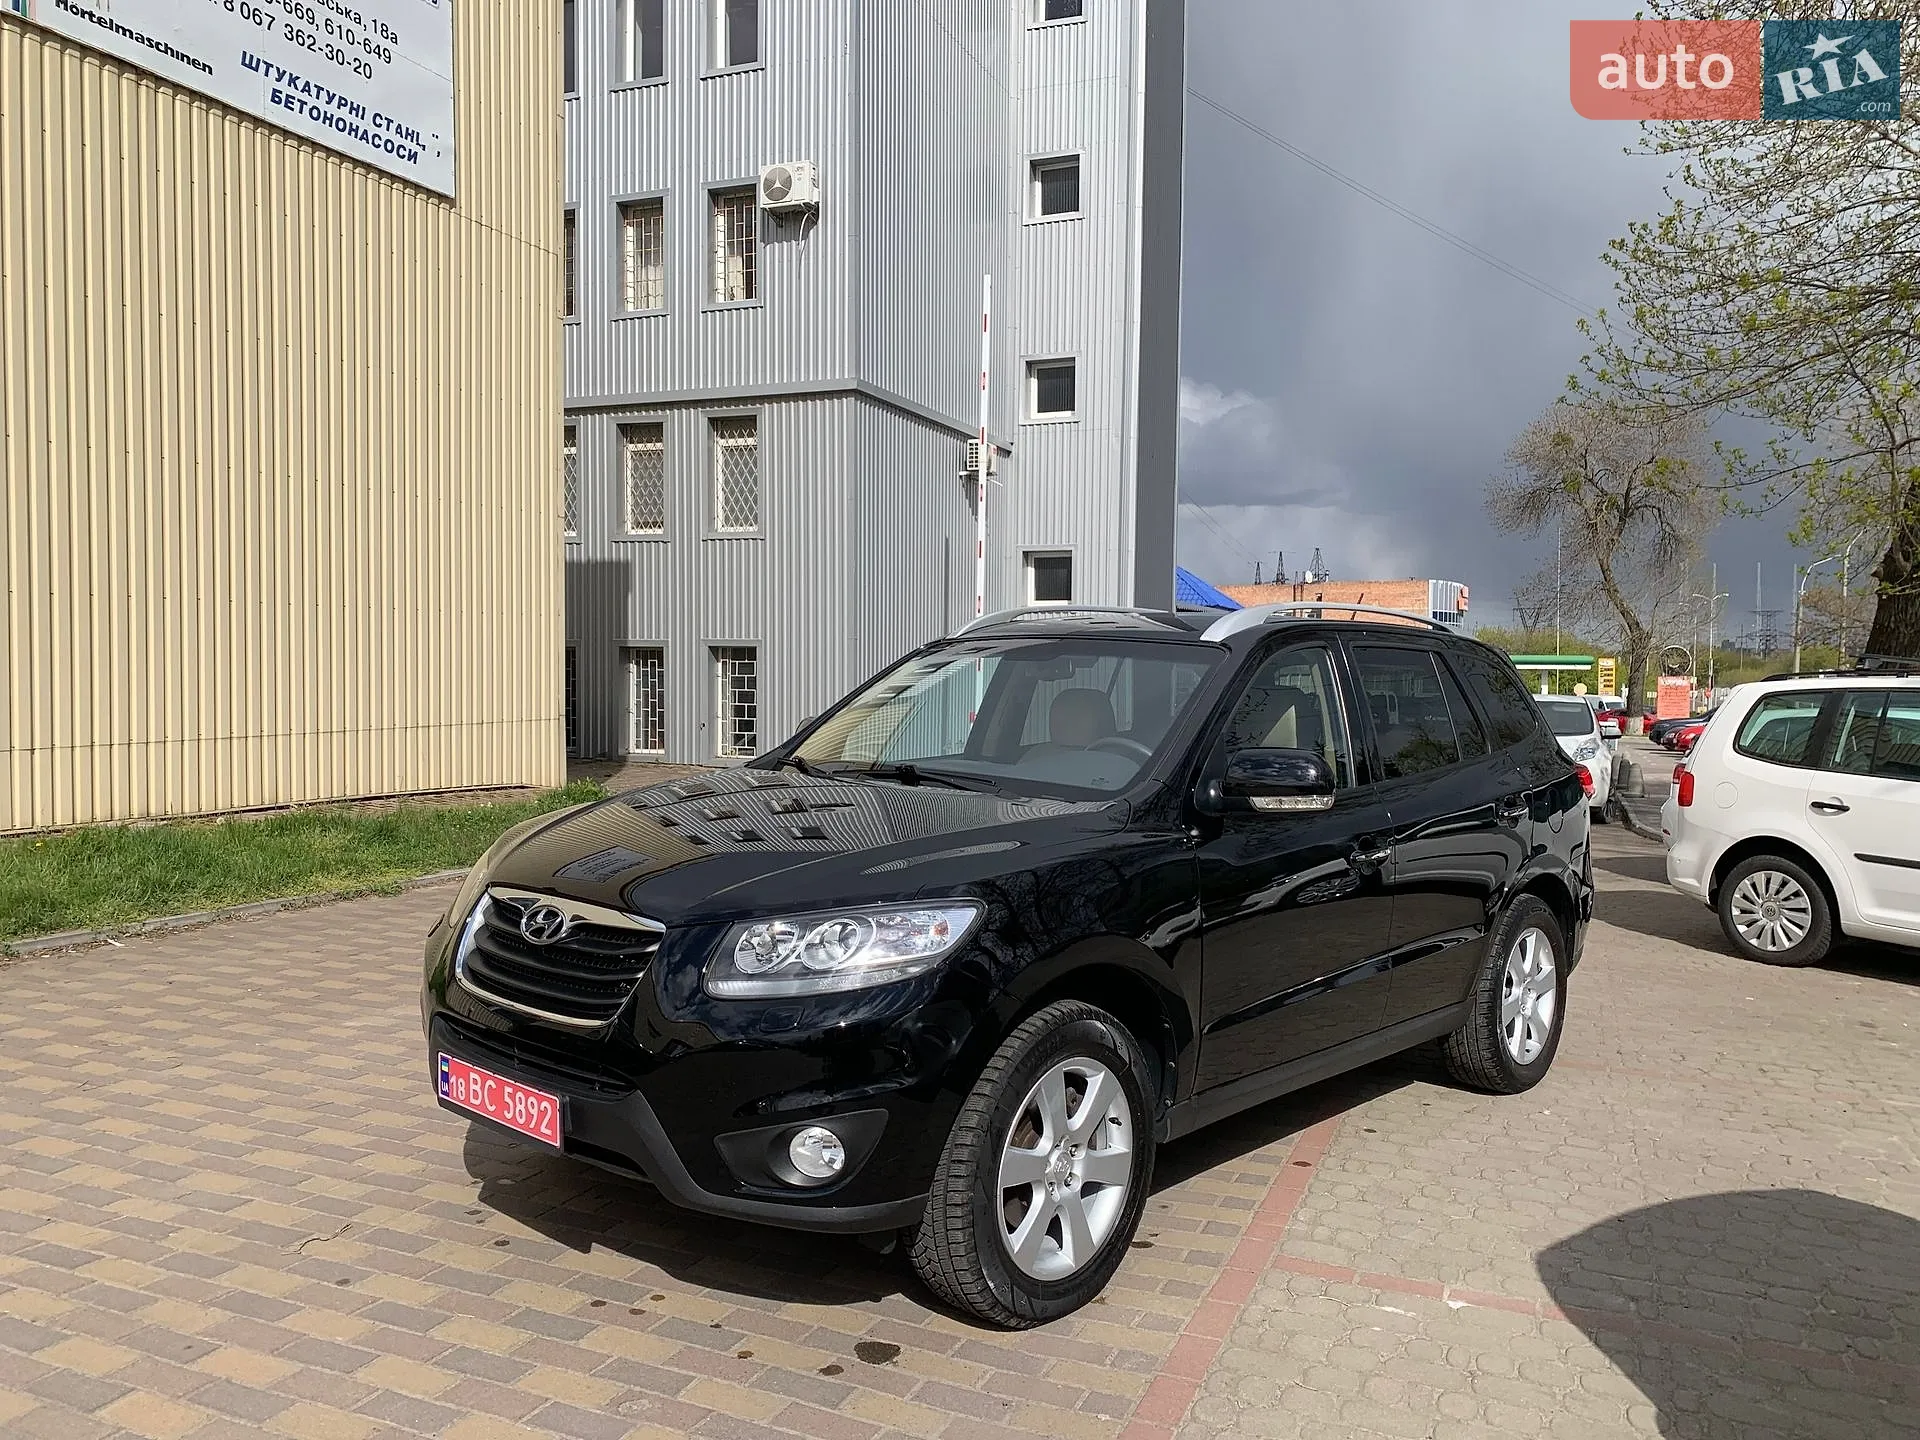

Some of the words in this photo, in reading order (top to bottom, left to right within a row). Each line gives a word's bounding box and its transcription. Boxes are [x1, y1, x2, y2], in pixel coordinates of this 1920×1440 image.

[55, 0, 213, 76] Mörtelmaschinen
[240, 1, 276, 31] 067
[283, 22, 373, 80] 362-30-20
[324, 17, 392, 65] 610-649
[240, 50, 366, 121] ШТУКАТУРНІ
[269, 87, 419, 165] БЕТОНОНАСОСИ
[449, 1074, 466, 1101] 18
[469, 1071, 497, 1112] BC
[503, 1085, 553, 1136] 5892
